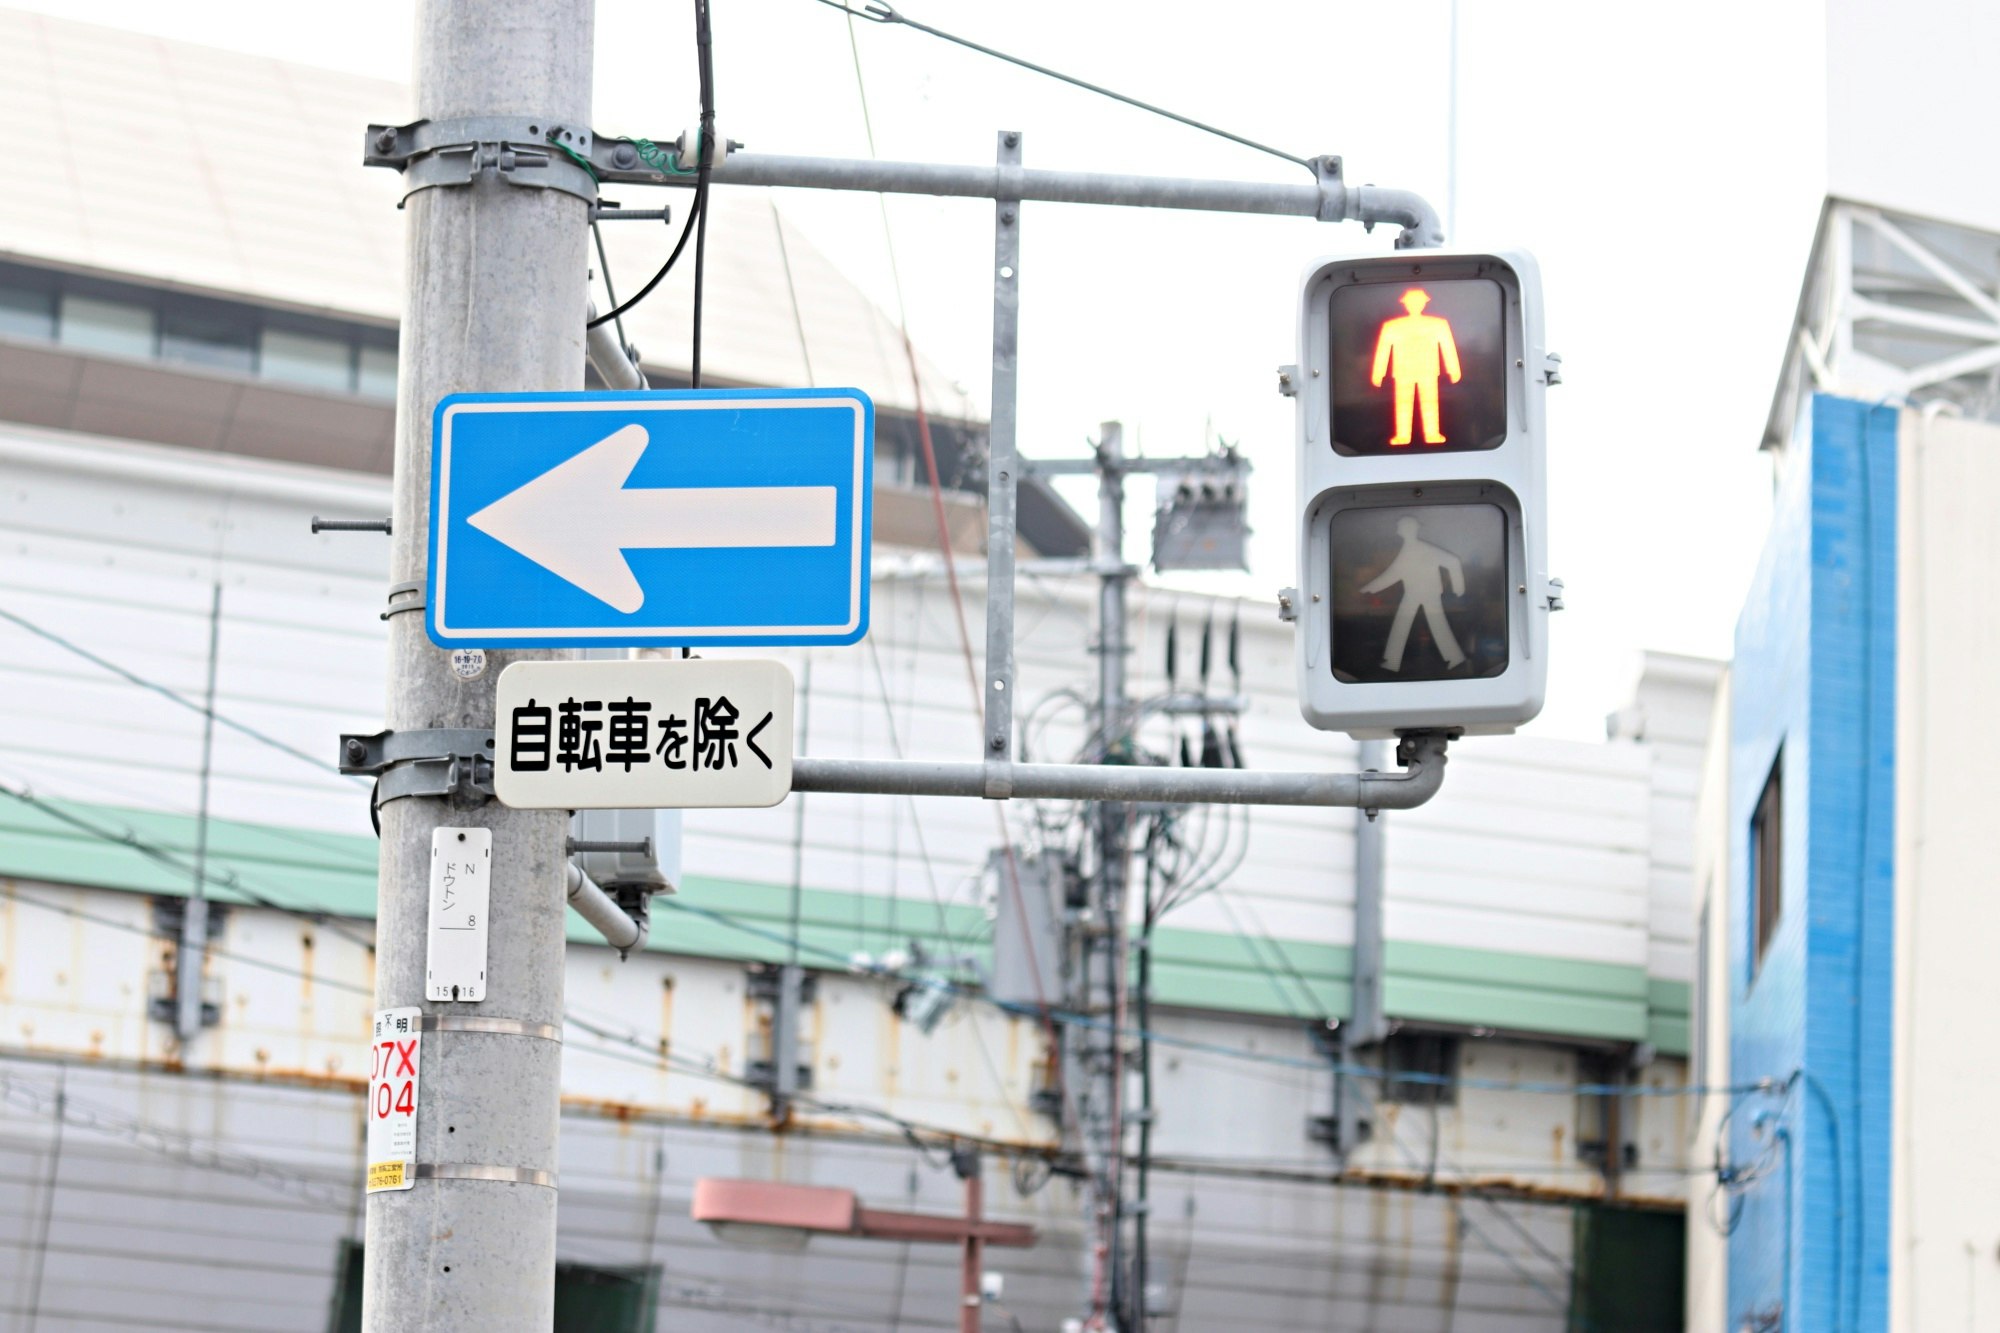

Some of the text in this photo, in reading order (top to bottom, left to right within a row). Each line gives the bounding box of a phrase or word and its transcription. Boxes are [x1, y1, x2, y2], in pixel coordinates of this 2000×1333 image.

[510, 696, 774, 773] 自転車を除く
[465, 863, 476, 875] N
[442, 862, 457, 911] ドウトン
[468, 915, 477, 927] 8
[436, 986, 475, 998] 15 16
